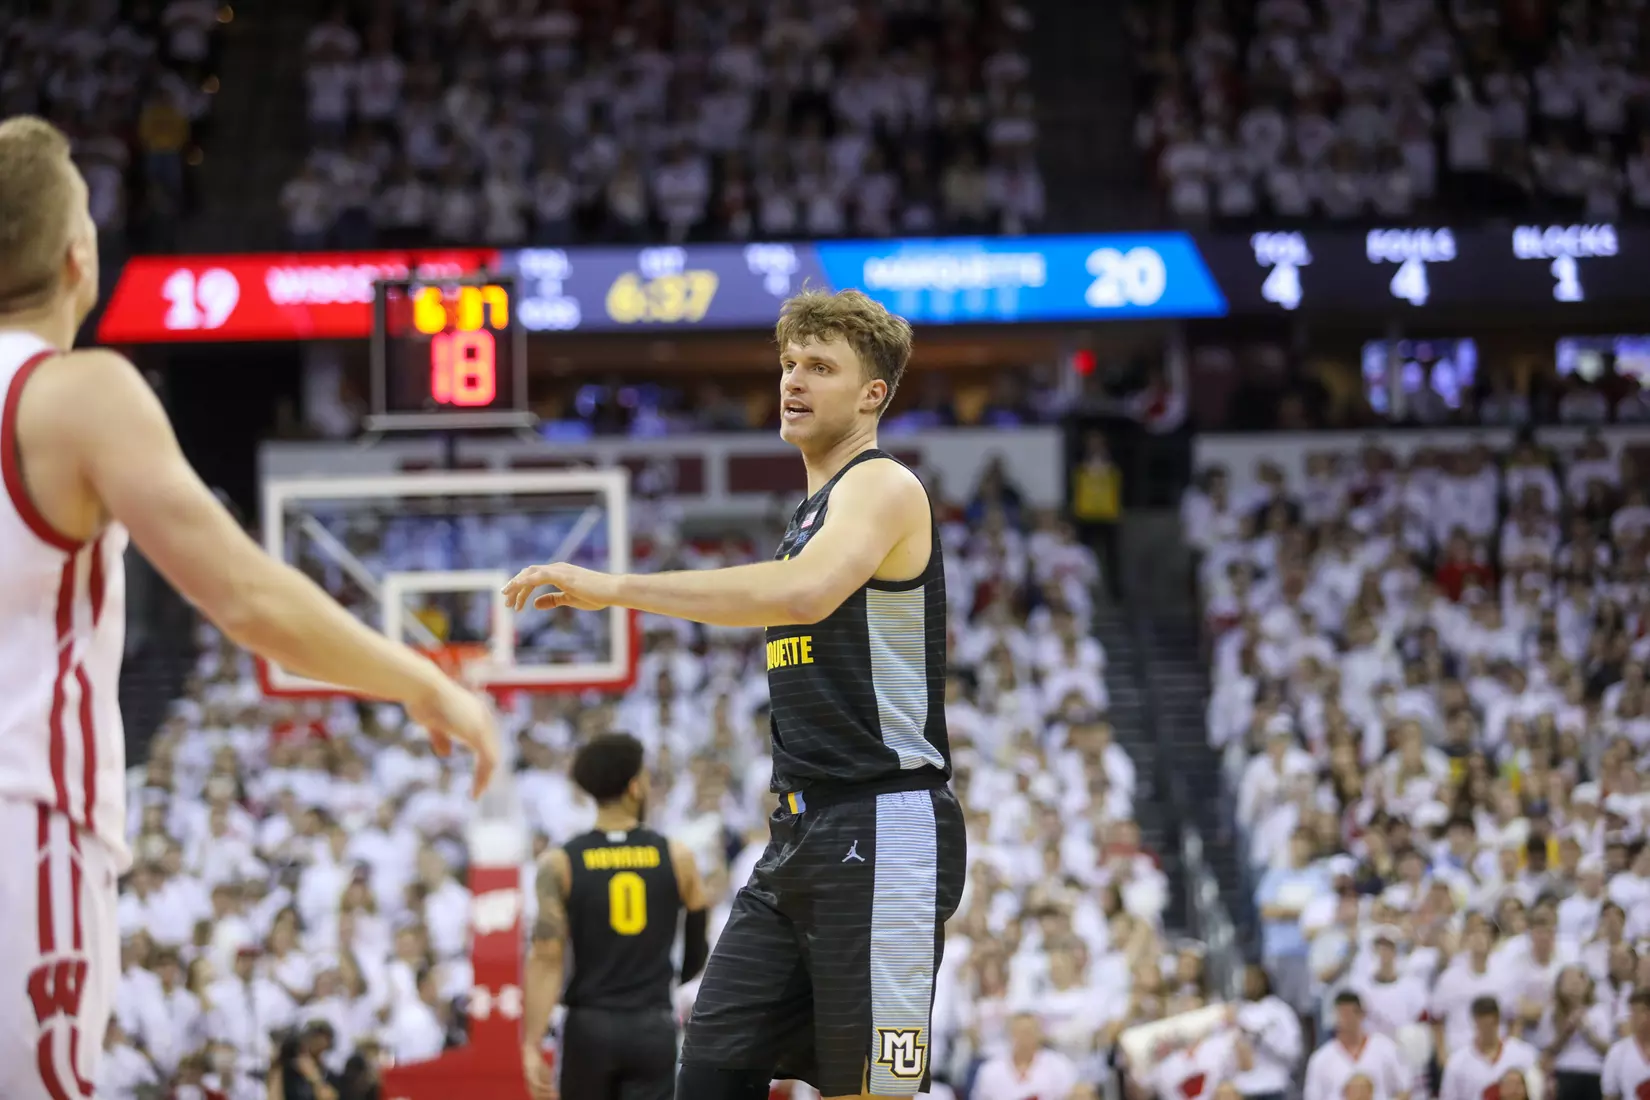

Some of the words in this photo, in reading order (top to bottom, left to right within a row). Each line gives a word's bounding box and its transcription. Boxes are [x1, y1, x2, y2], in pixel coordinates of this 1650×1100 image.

[1366, 227, 1456, 263] FOULS
[1512, 224, 1618, 259] BLOCKS
[161, 268, 240, 330] 19
[1085, 246, 1166, 307] 20
[1261, 261, 1304, 309] 4
[1390, 257, 1429, 306] 4
[1551, 254, 1584, 302] 1
[431, 329, 496, 407] 18
[608, 870, 647, 936] 0
[876, 1027, 928, 1080] MU
